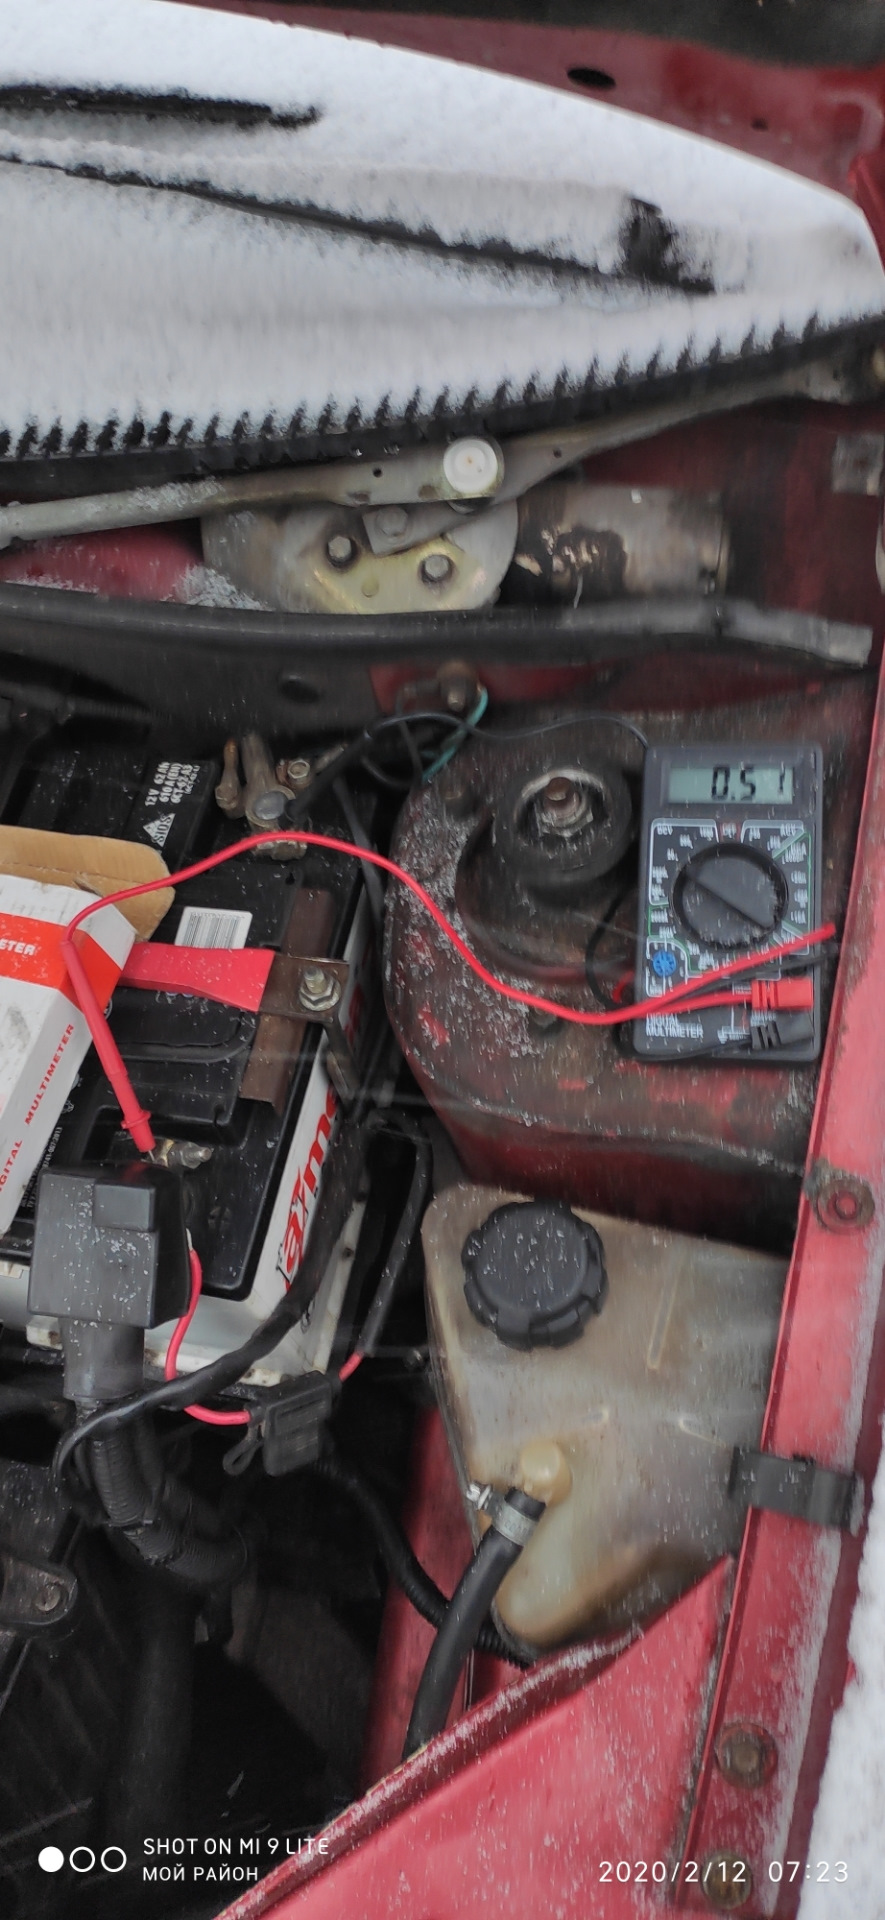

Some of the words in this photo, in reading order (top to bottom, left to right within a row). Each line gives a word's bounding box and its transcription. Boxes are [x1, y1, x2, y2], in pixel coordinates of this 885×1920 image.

[145, 788, 160, 807] 12V
[646, 1022, 704, 1038] MULTIMETER
[24, 1024, 75, 1125] MULTIMETER
